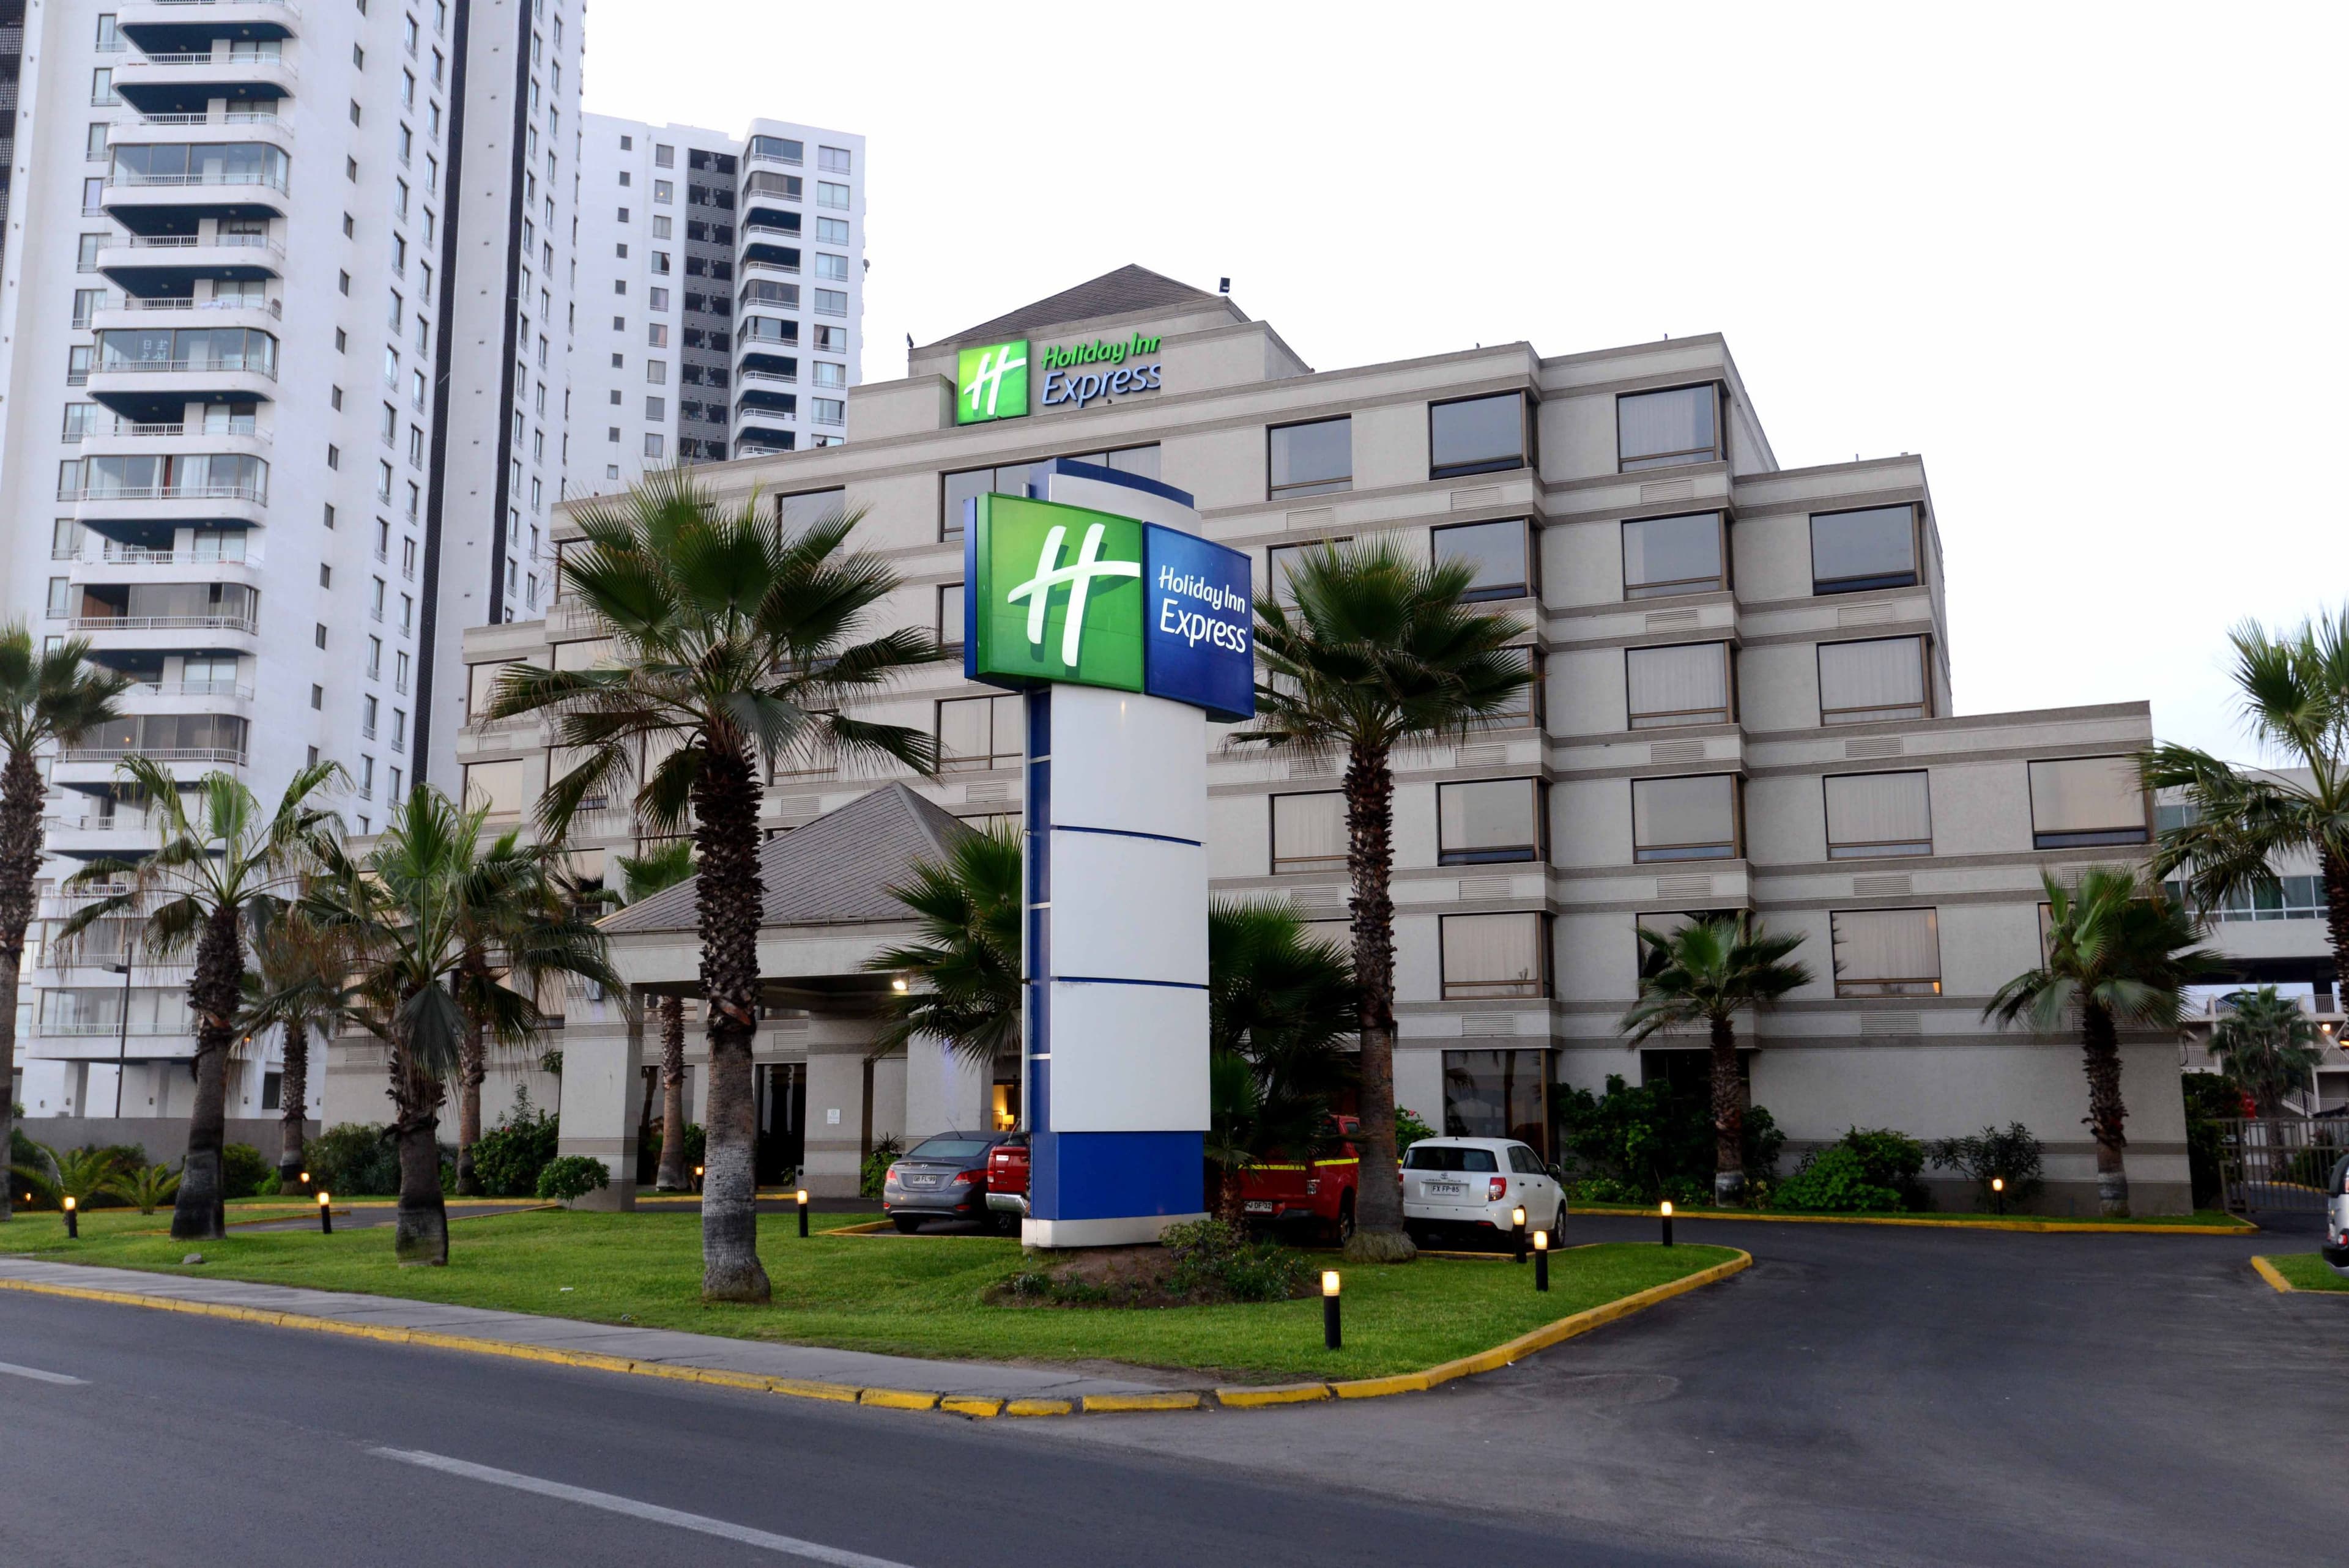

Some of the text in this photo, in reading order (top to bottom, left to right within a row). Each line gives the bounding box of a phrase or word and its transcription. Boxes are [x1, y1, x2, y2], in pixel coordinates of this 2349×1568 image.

[1041, 332, 1162, 370] Holiday Inn
[1042, 363, 1161, 409] Express
[1159, 564, 1245, 614] Holiday Inn
[1160, 597, 1247, 653] Express
